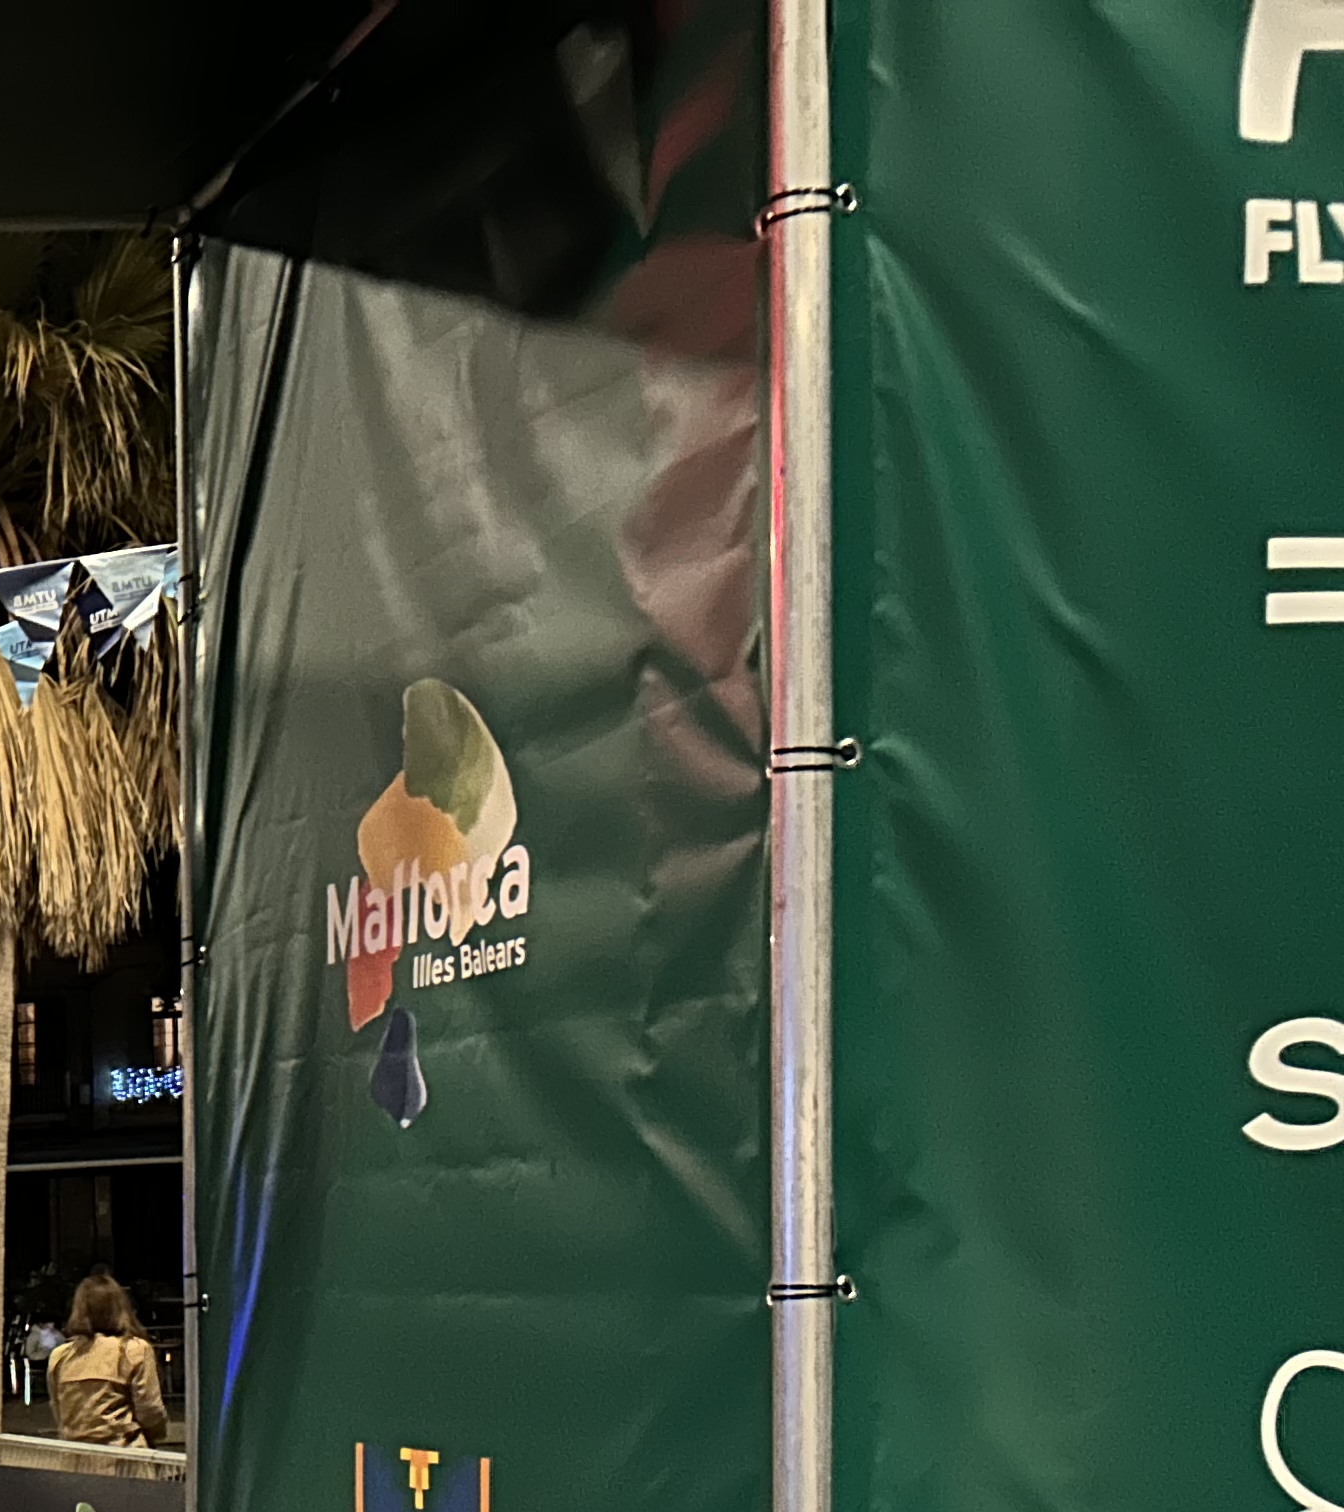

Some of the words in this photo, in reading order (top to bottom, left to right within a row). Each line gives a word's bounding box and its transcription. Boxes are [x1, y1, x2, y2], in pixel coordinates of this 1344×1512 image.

[326, 844, 530, 965] Mallorca
[413, 952, 455, 989] Illes
[459, 936, 526, 980] Balears
